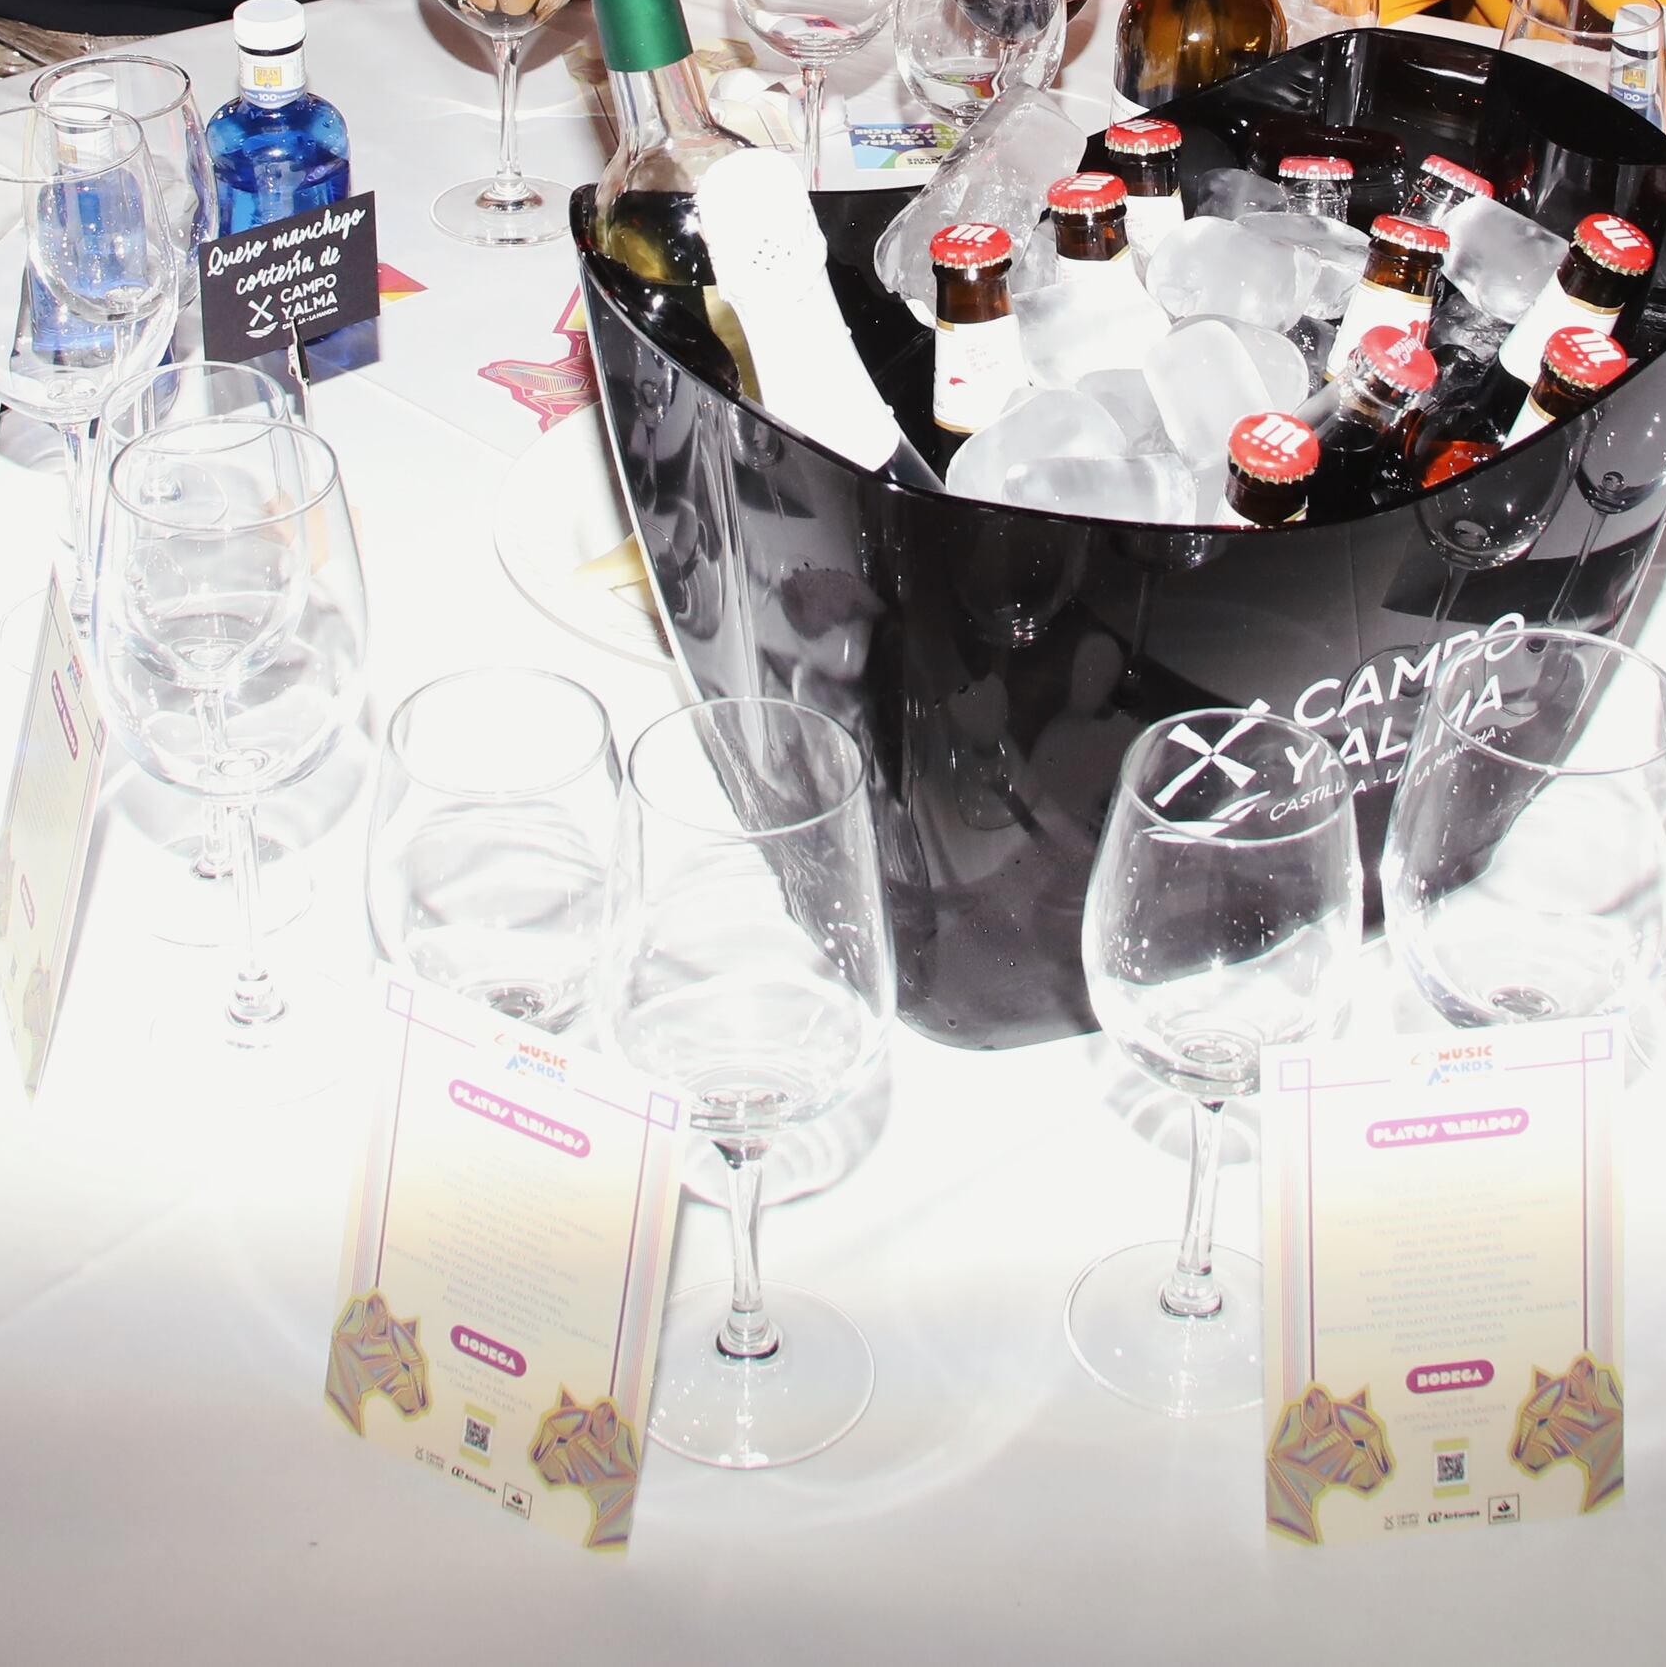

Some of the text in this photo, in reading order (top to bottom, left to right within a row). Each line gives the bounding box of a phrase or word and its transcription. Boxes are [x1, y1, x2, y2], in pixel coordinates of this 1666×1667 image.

[207, 208, 366, 277] Queso manchego
[236, 246, 341, 296] cortesía de
[280, 273, 337, 303] CAMPO
[1293, 613, 1526, 728] CAMPO
[519, 1042, 568, 1070] MUSIC
[1438, 1045, 1493, 1062] MUSIC
[505, 1054, 565, 1083] AWARDS
[1427, 1060, 1493, 1086] AWARDS
[1373, 1123, 1437, 1143] PLATOS
[459, 1333, 517, 1371] BODEGA
[1417, 1368, 1484, 1388] BODEGA
